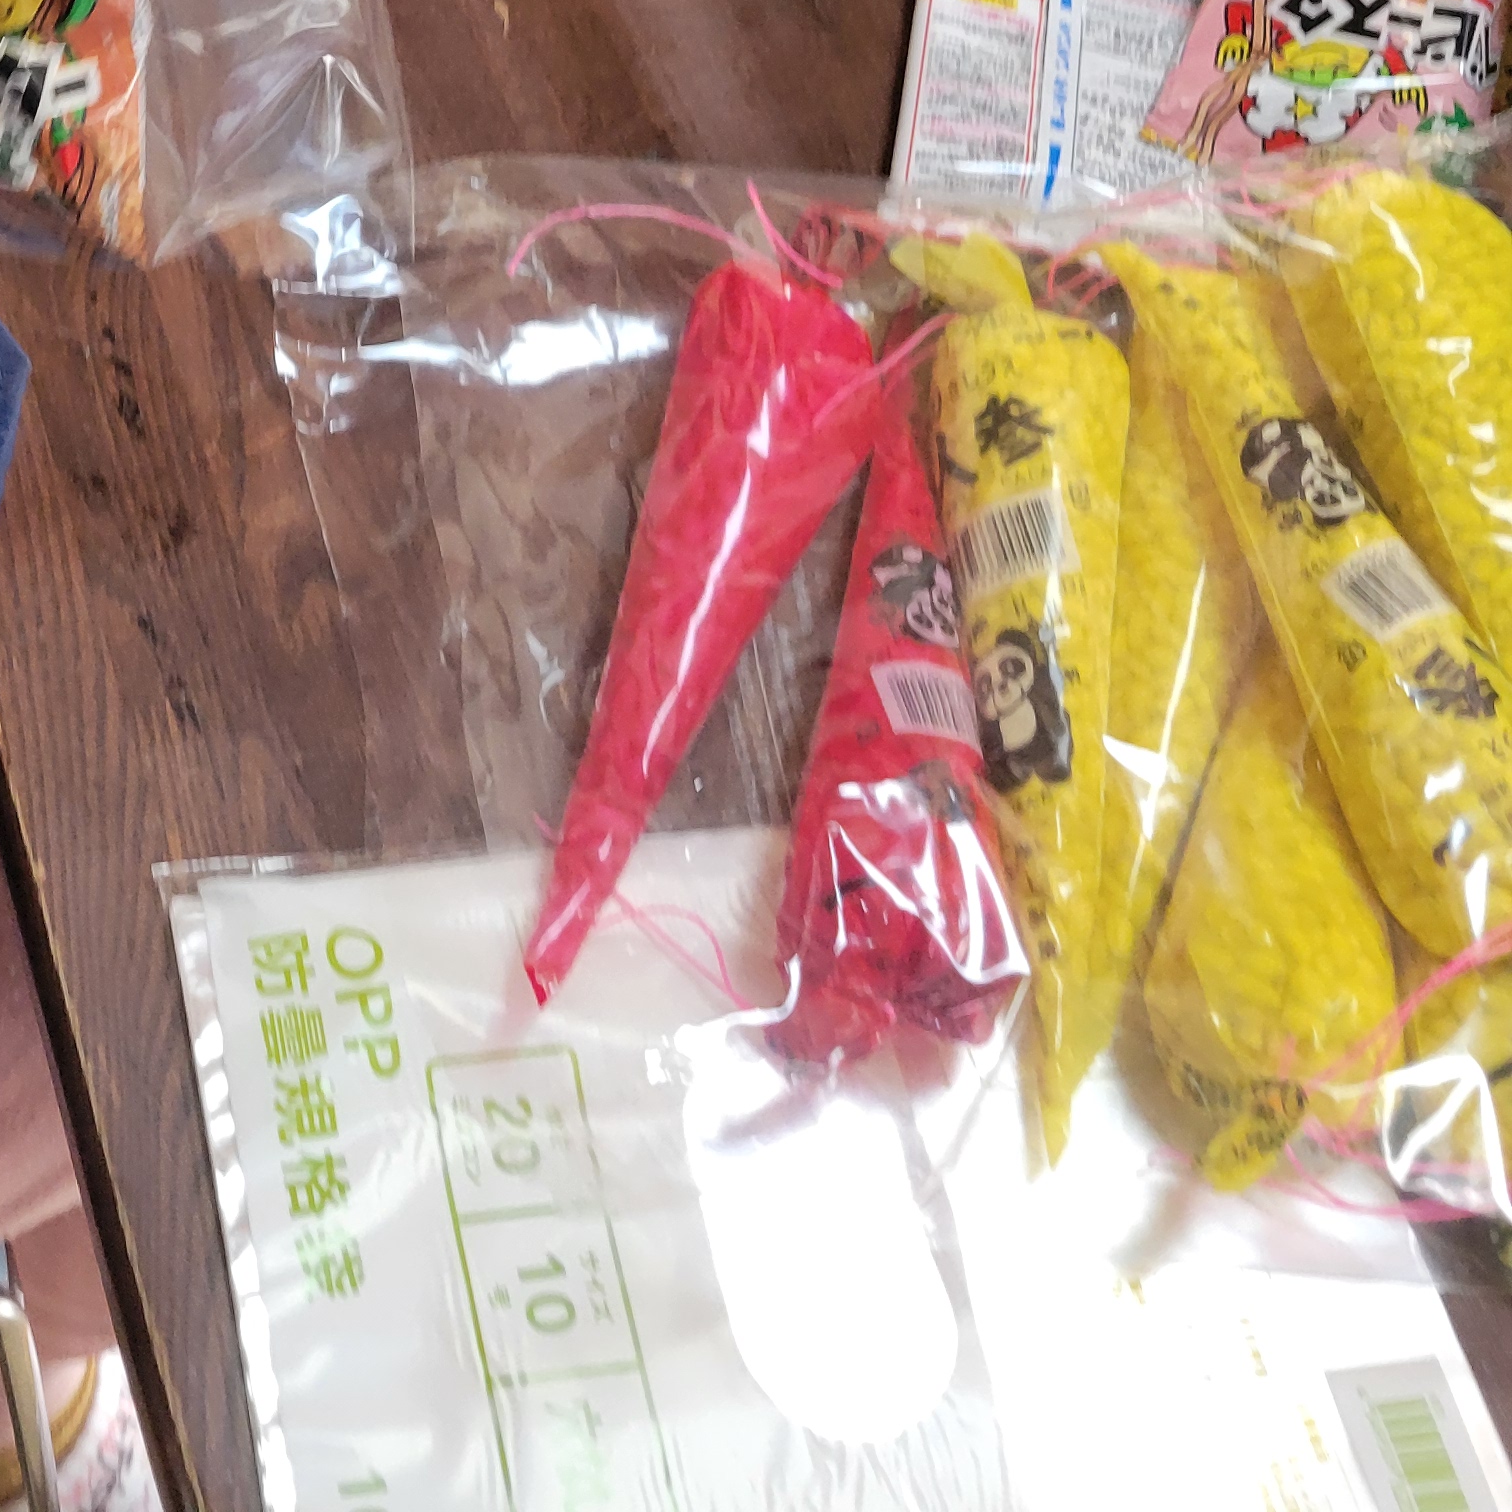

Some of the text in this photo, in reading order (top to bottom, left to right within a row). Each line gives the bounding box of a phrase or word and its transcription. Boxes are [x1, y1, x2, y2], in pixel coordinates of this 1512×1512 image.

[326, 924, 402, 1081] OPP
[482, 1091, 542, 1178] 20
[517, 1250, 578, 1336] 10
